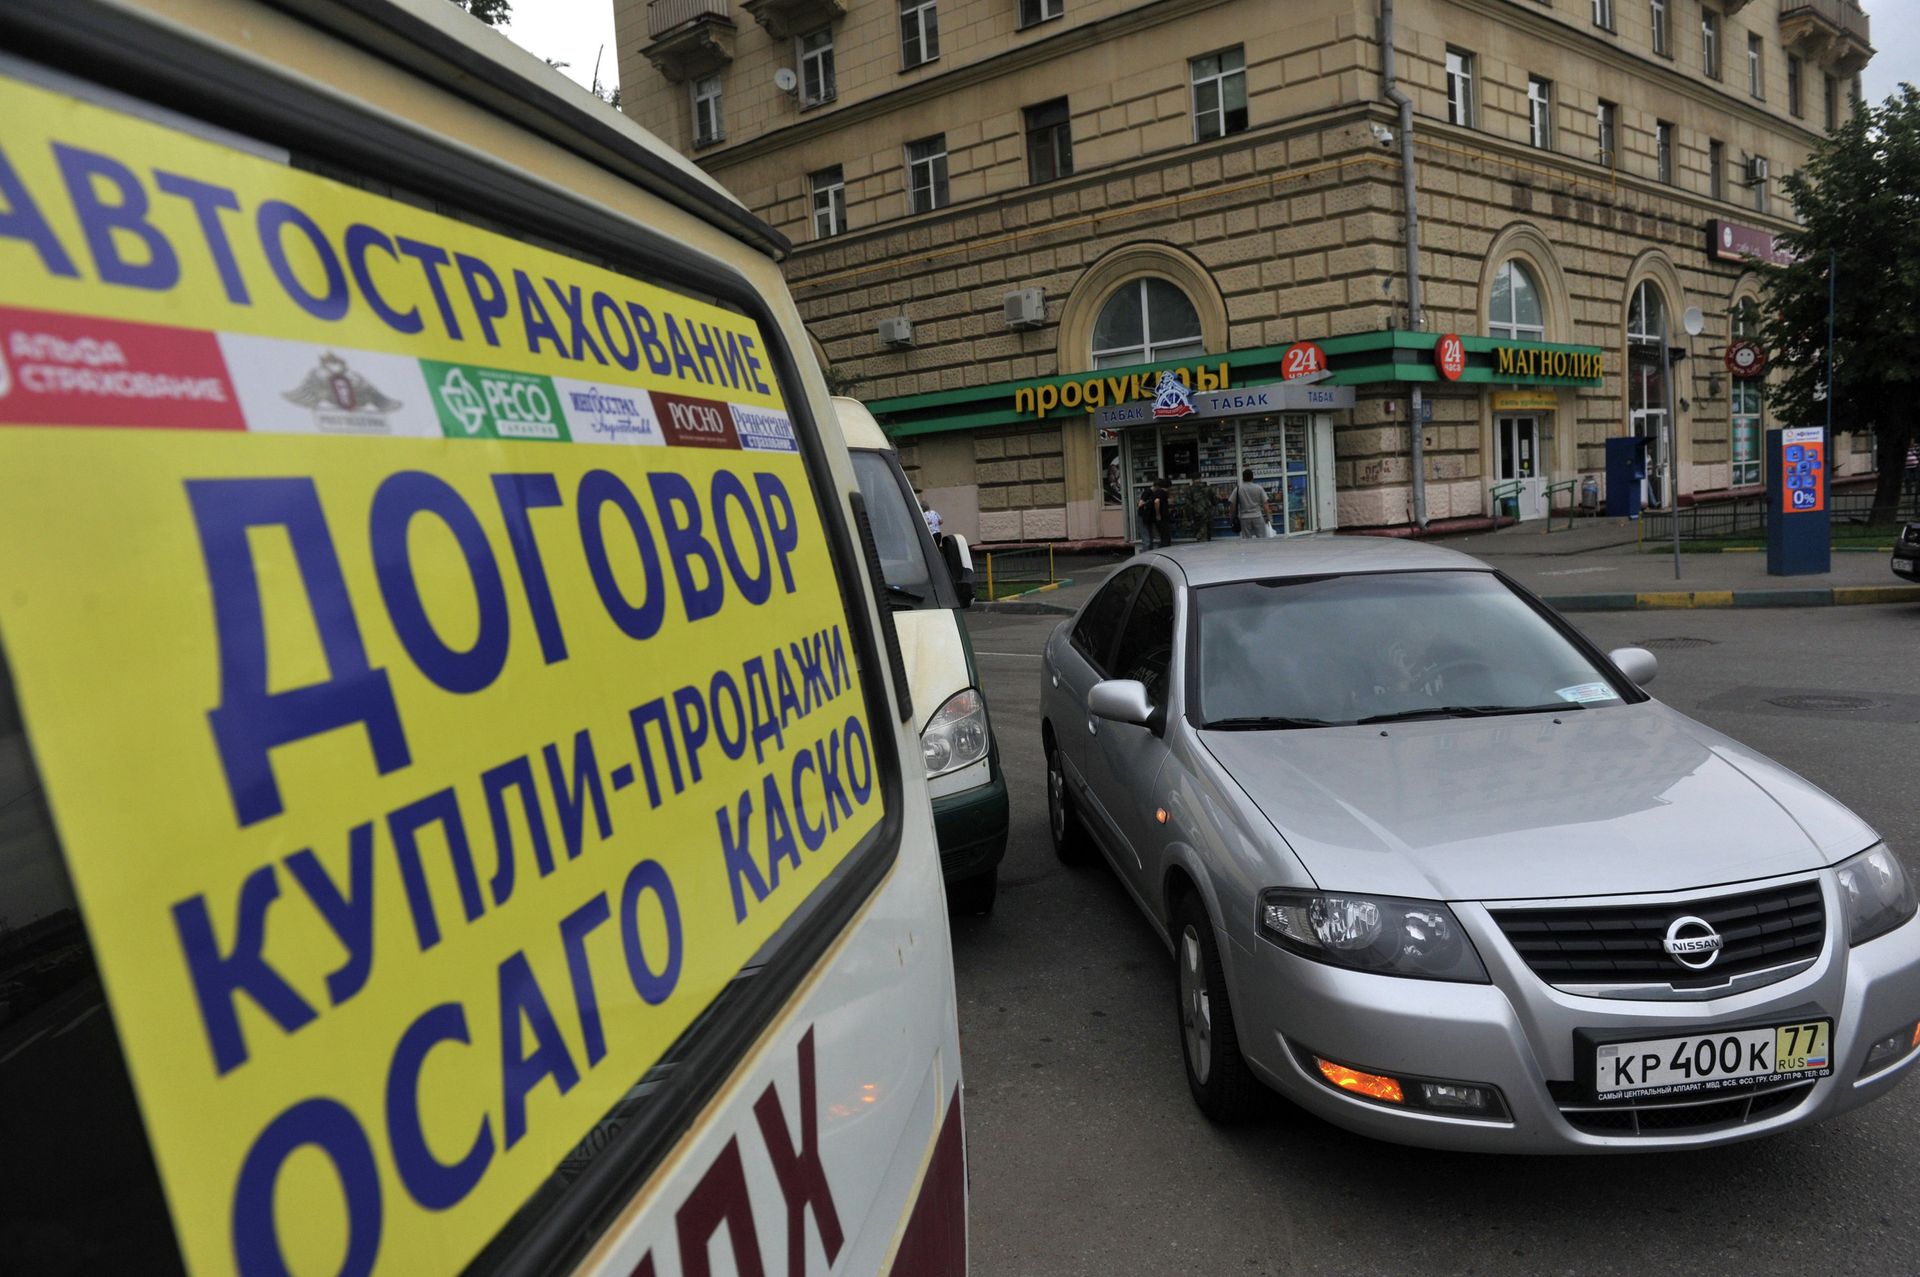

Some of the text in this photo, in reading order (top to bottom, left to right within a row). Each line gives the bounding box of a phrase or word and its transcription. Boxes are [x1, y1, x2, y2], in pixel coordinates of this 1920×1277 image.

[1288, 347, 1317, 372] 24
[1444, 339, 1461, 363] 24
[1498, 346, 1604, 379] МАГНОЛИЯ
[481, 379, 552, 422] РЕСО
[1211, 393, 1268, 410] ТАБАК
[1308, 391, 1334, 403] ТАБАК
[667, 402, 724, 433] РОСНО
[1102, 407, 1144, 422] ТАБАК
[1793, 489, 1815, 505] 0%
[184, 470, 797, 828] ДОГОВОР
[169, 624, 852, 1078] КУПЛИ-ПРОДАЖИ
[1672, 938, 1720, 951] NISSAN
[230, 715, 871, 1277] ОСАГО КАСКО
[1784, 1024, 1818, 1057] 77
[1778, 1057, 1805, 1070] RUS
[1598, 1090, 1623, 1101] САМЫЙ
[1624, 1085, 1671, 1098] ЦЕНТРАЛЬНЫЙ
[1673, 1083, 1701, 1093] АППАРАТ
